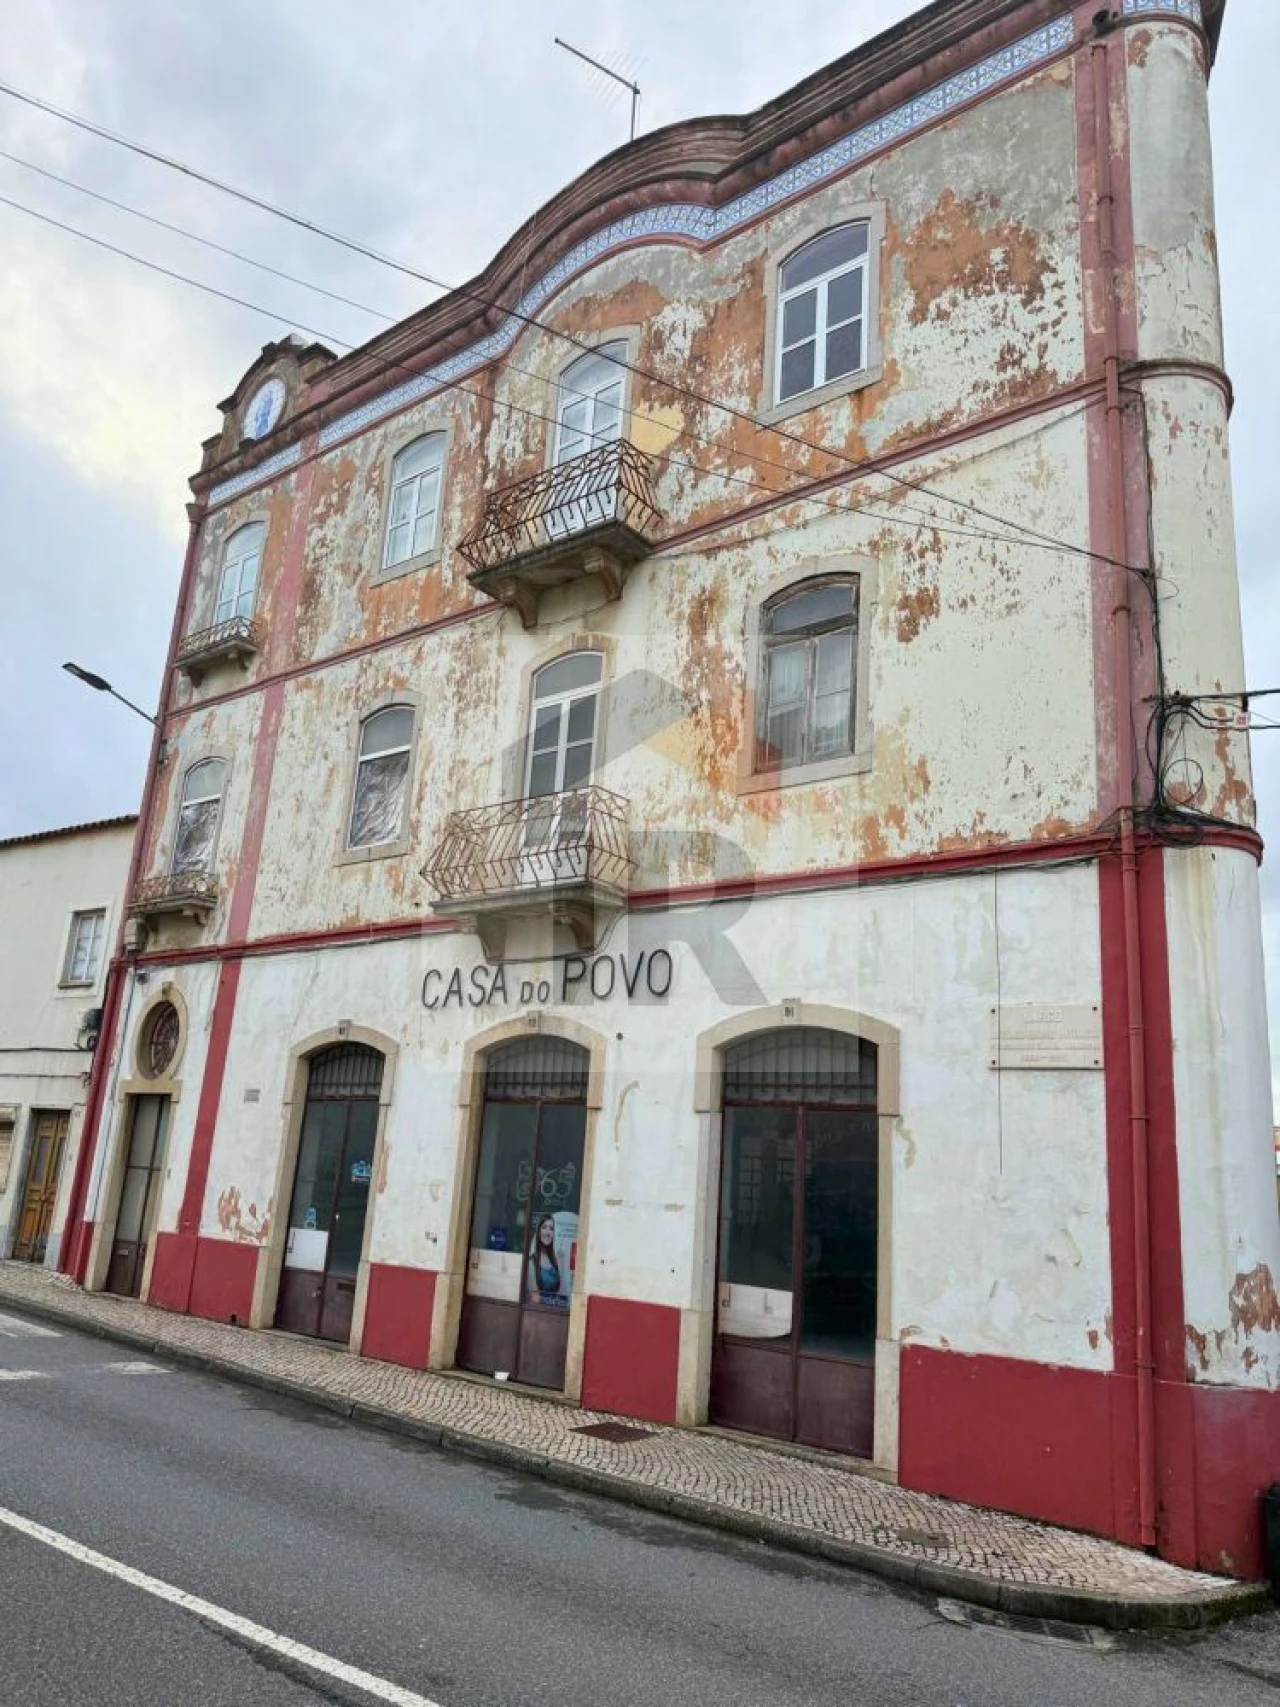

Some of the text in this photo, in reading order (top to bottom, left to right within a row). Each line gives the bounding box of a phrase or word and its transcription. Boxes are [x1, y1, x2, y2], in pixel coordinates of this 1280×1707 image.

[422, 948, 673, 1009] CASA DO POVO
